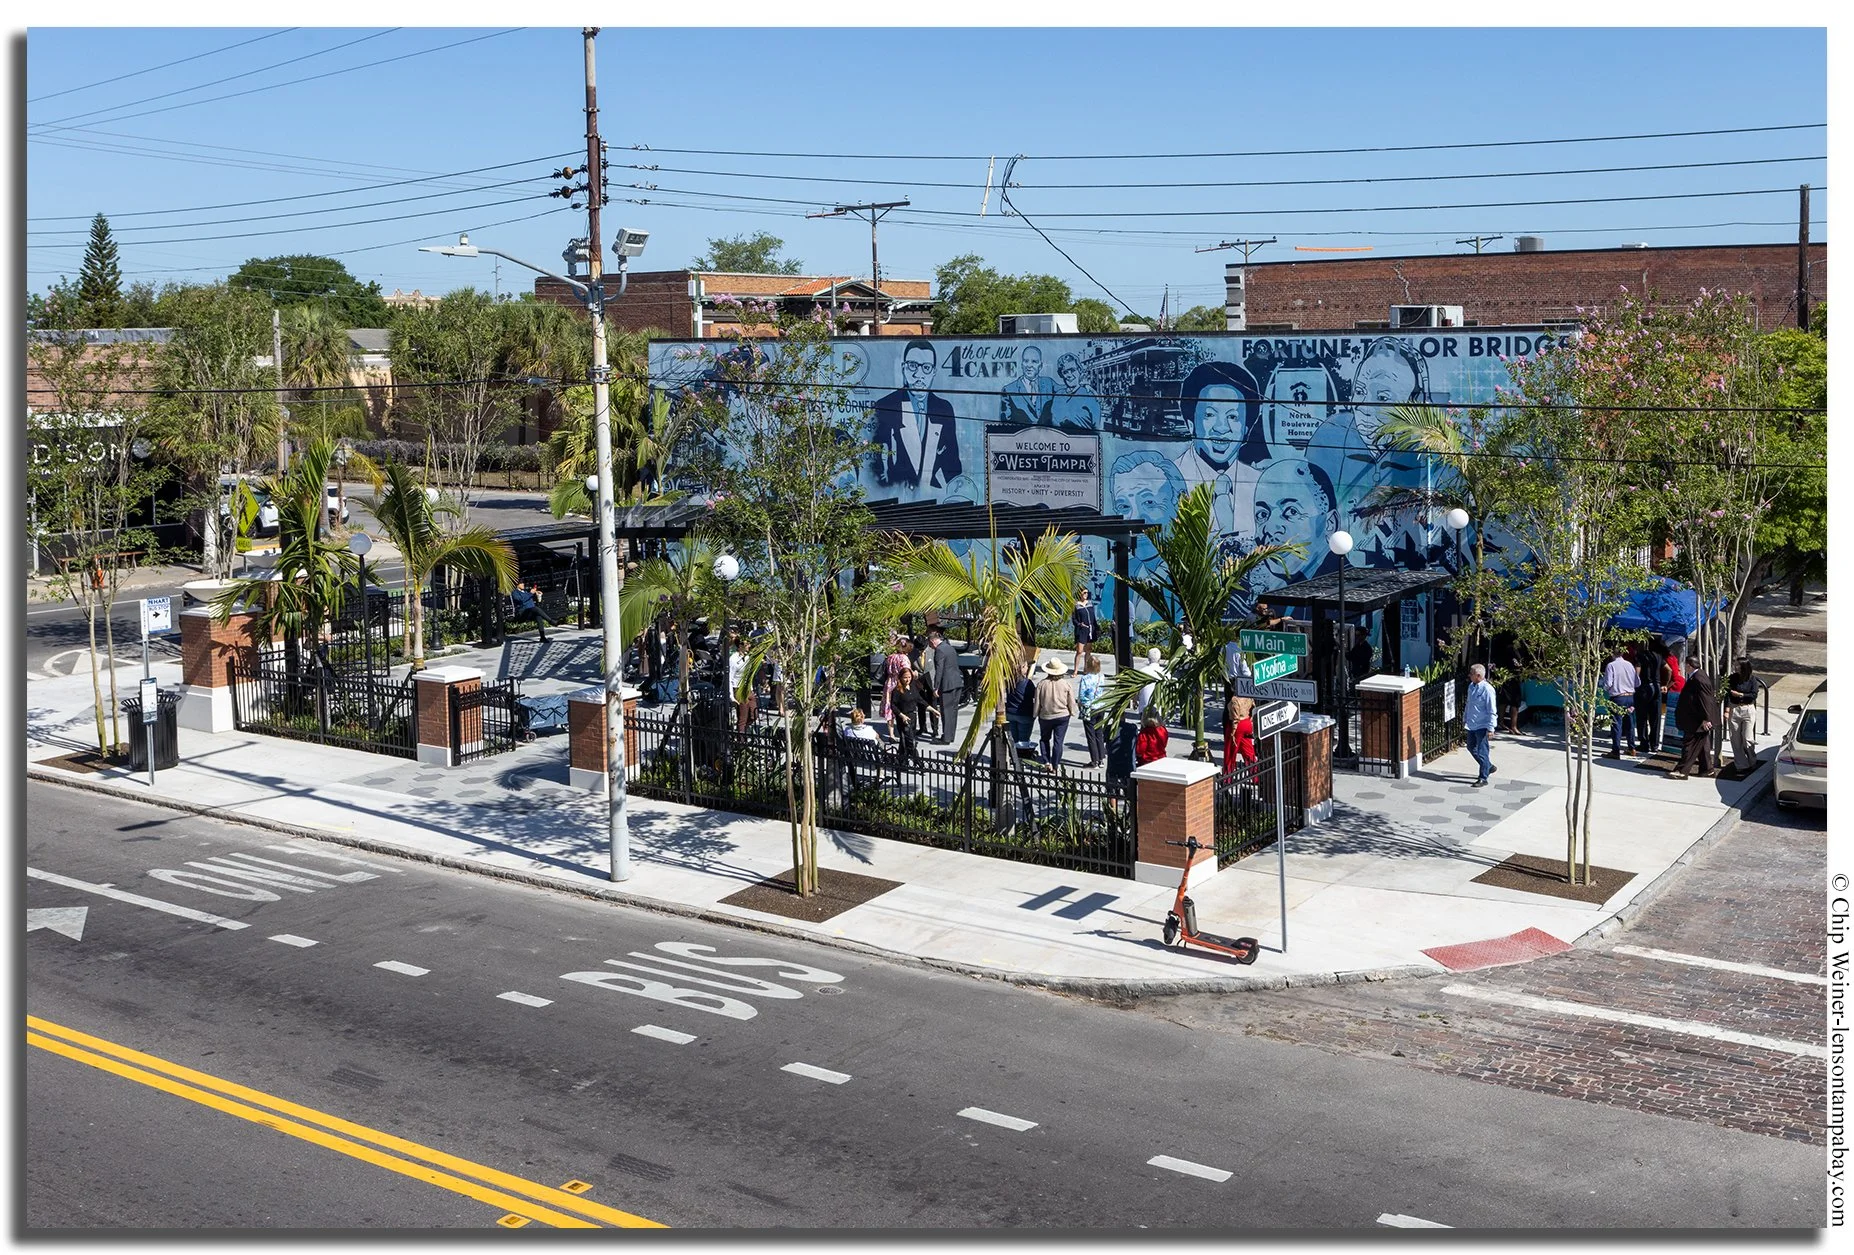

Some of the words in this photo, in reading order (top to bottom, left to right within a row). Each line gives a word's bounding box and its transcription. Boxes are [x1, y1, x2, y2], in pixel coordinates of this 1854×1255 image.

[976, 346, 991, 359] OF
[992, 345, 1018, 360] JULY
[1242, 338, 1352, 360] FORTUNE
[964, 361, 1017, 378] CAFE
[1289, 411, 1312, 419] North
[1281, 420, 1319, 428] Boulevard
[1016, 442, 1057, 452] WELCOME
[1060, 442, 1071, 452] TO
[1001, 487, 1026, 495] HISTORY
[1030, 488, 1049, 496] UNITY
[164, 610, 169, 618] 7
[1242, 635, 1251, 647] W
[1254, 634, 1286, 652] Main
[1254, 666, 1260, 680] N
[1260, 657, 1287, 680] Ysolina
[1240, 680, 1269, 696] Moses
[1271, 682, 1299, 699] White
[1263, 713, 1275, 728] ONE
[1276, 707, 1289, 721] WAY
[146, 842, 407, 902] ONLY
[559, 941, 846, 1021] BUS
